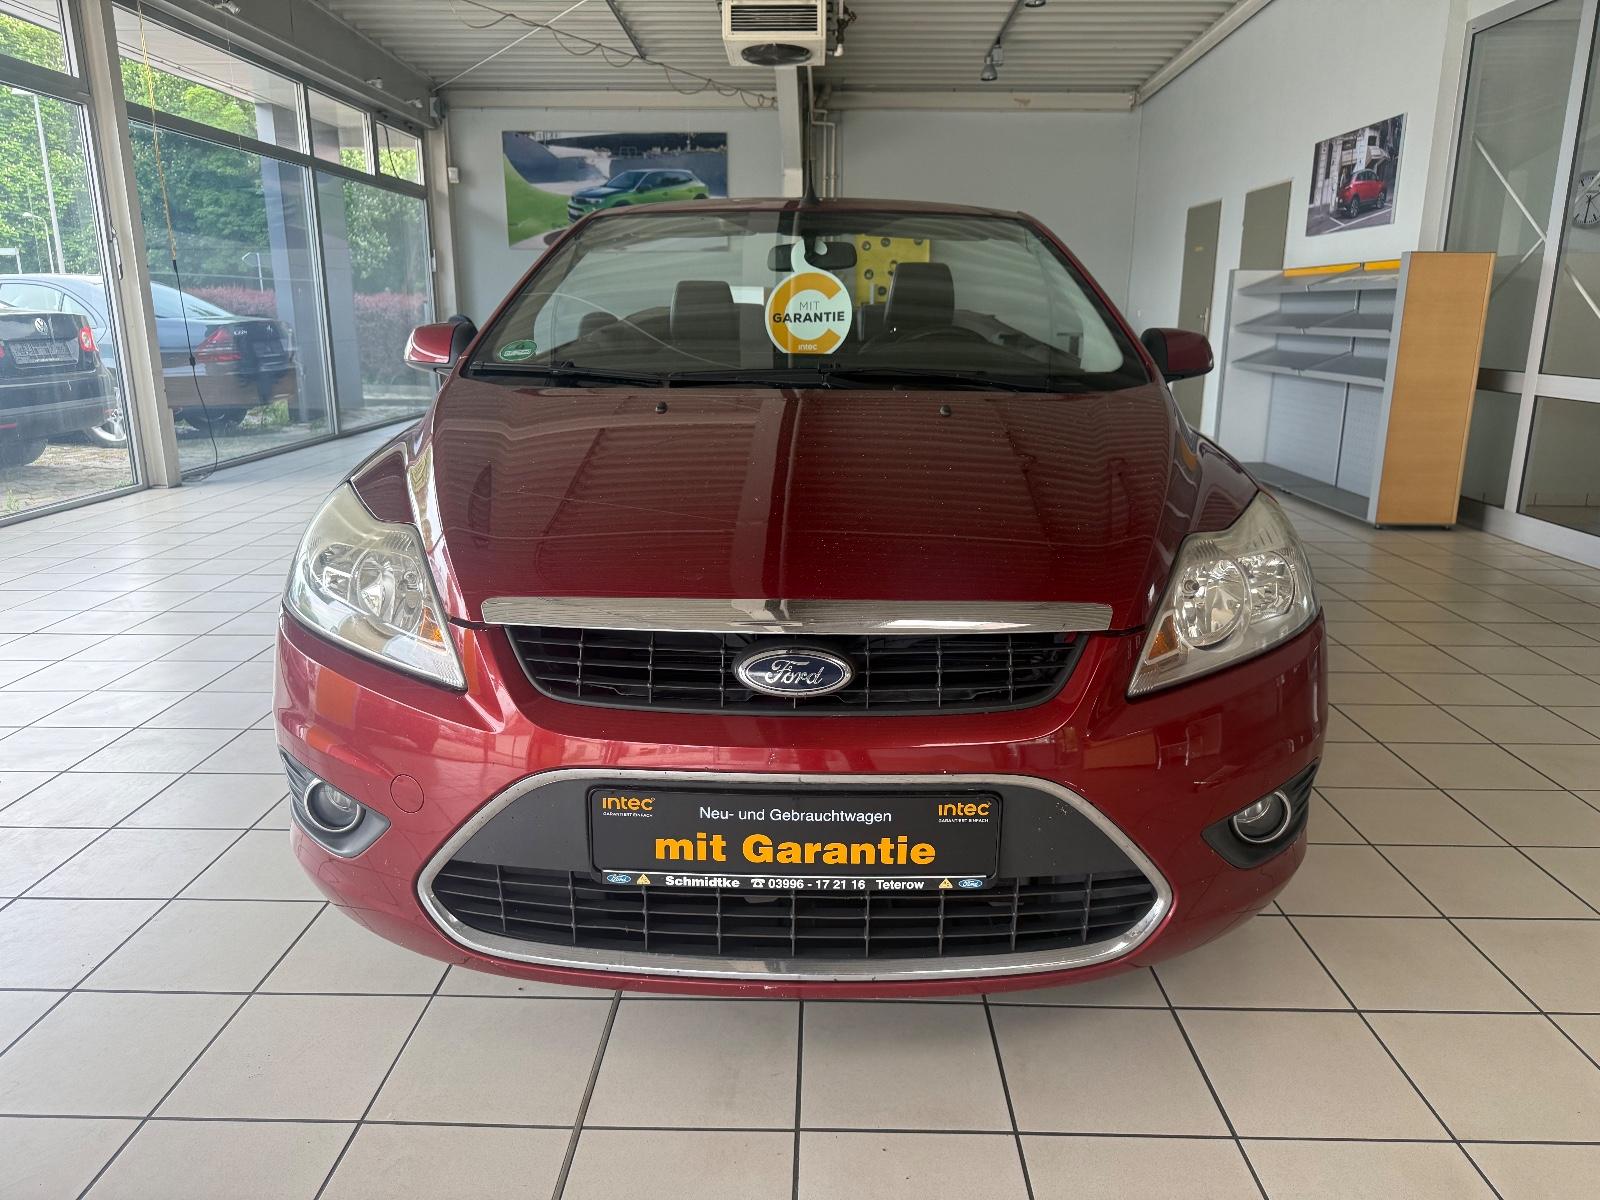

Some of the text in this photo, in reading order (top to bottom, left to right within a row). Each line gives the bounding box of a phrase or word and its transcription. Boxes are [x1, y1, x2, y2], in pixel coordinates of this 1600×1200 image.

[799, 300, 820, 311] MIT
[772, 311, 845, 323] GARANTIE
[764, 659, 825, 685] Ford
[602, 796, 653, 811] intec
[938, 802, 990, 816] intec
[699, 806, 892, 825] Neu- und Gebrauchtwagen
[655, 832, 936, 865] mit Garantie
[665, 875, 741, 888] Schmidtke
[768, 878, 804, 890] 03996
[815, 879, 831, 890] 17
[832, 879, 847, 890] 21
[851, 879, 866, 890] 16
[876, 879, 925, 890] Teterow
